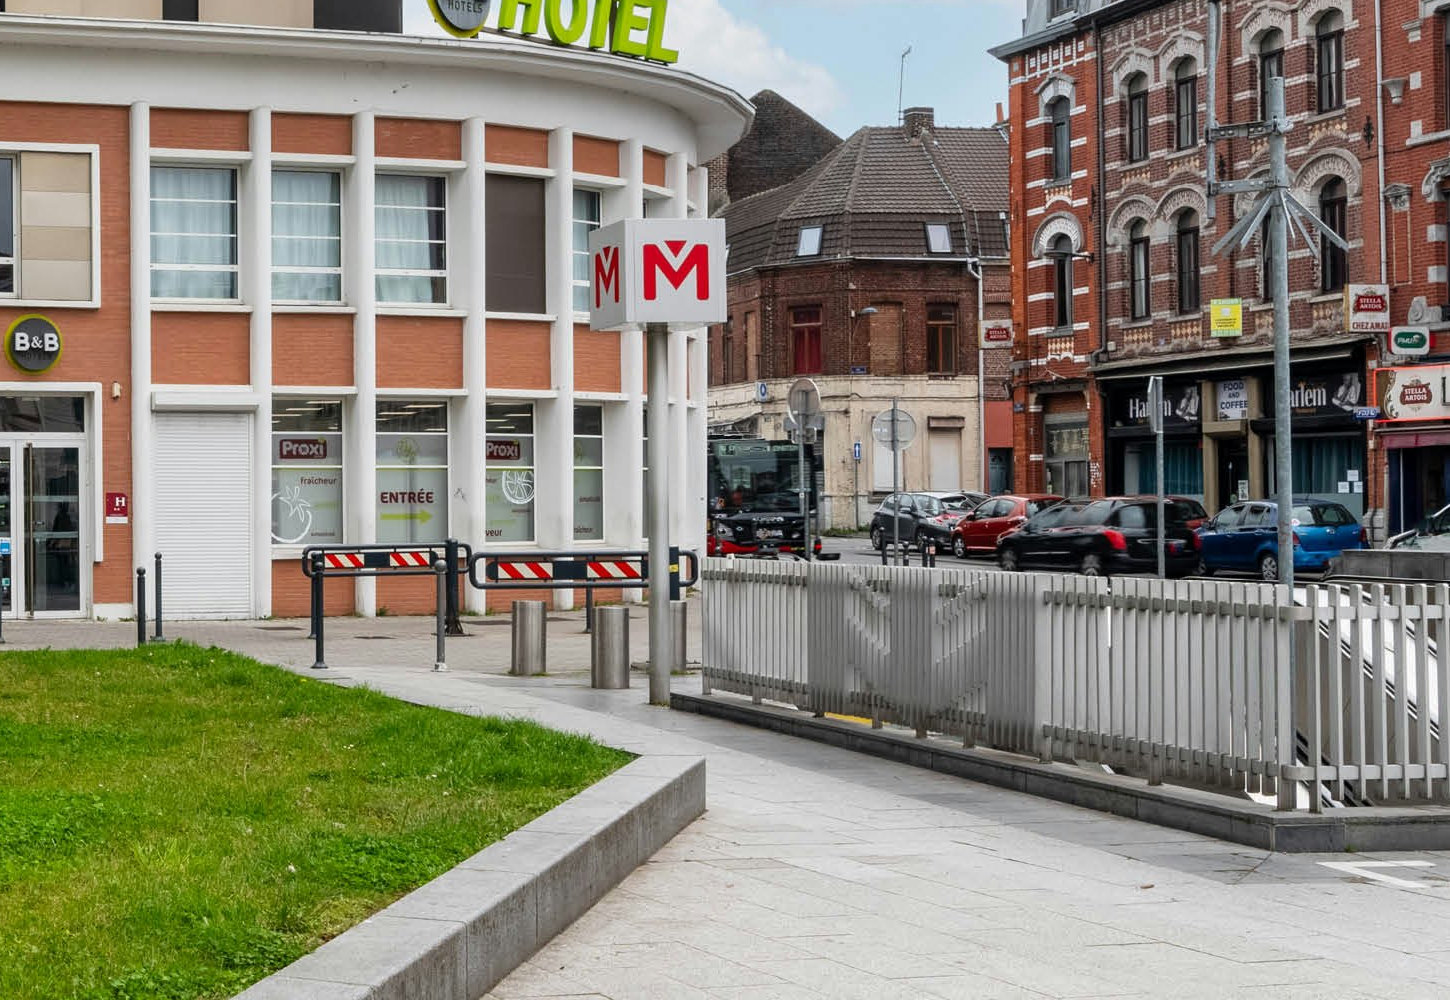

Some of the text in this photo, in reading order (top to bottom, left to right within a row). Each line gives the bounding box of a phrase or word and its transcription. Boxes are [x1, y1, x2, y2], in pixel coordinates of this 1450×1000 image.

[448, 0, 483, 13] HOTELS
[643, 240, 709, 300] M
[15, 332, 59, 351] B&B
[1223, 382, 1244, 391] FOOD
[1289, 386, 1326, 407] arlem
[1220, 400, 1249, 409] COFFEE
[282, 440, 324, 456] Proxi
[486, 442, 519, 457] Proxi
[300, 476, 337, 485] fraîcheur
[115, 497, 126, 506] H
[380, 489, 435, 503] ENTRÉE
